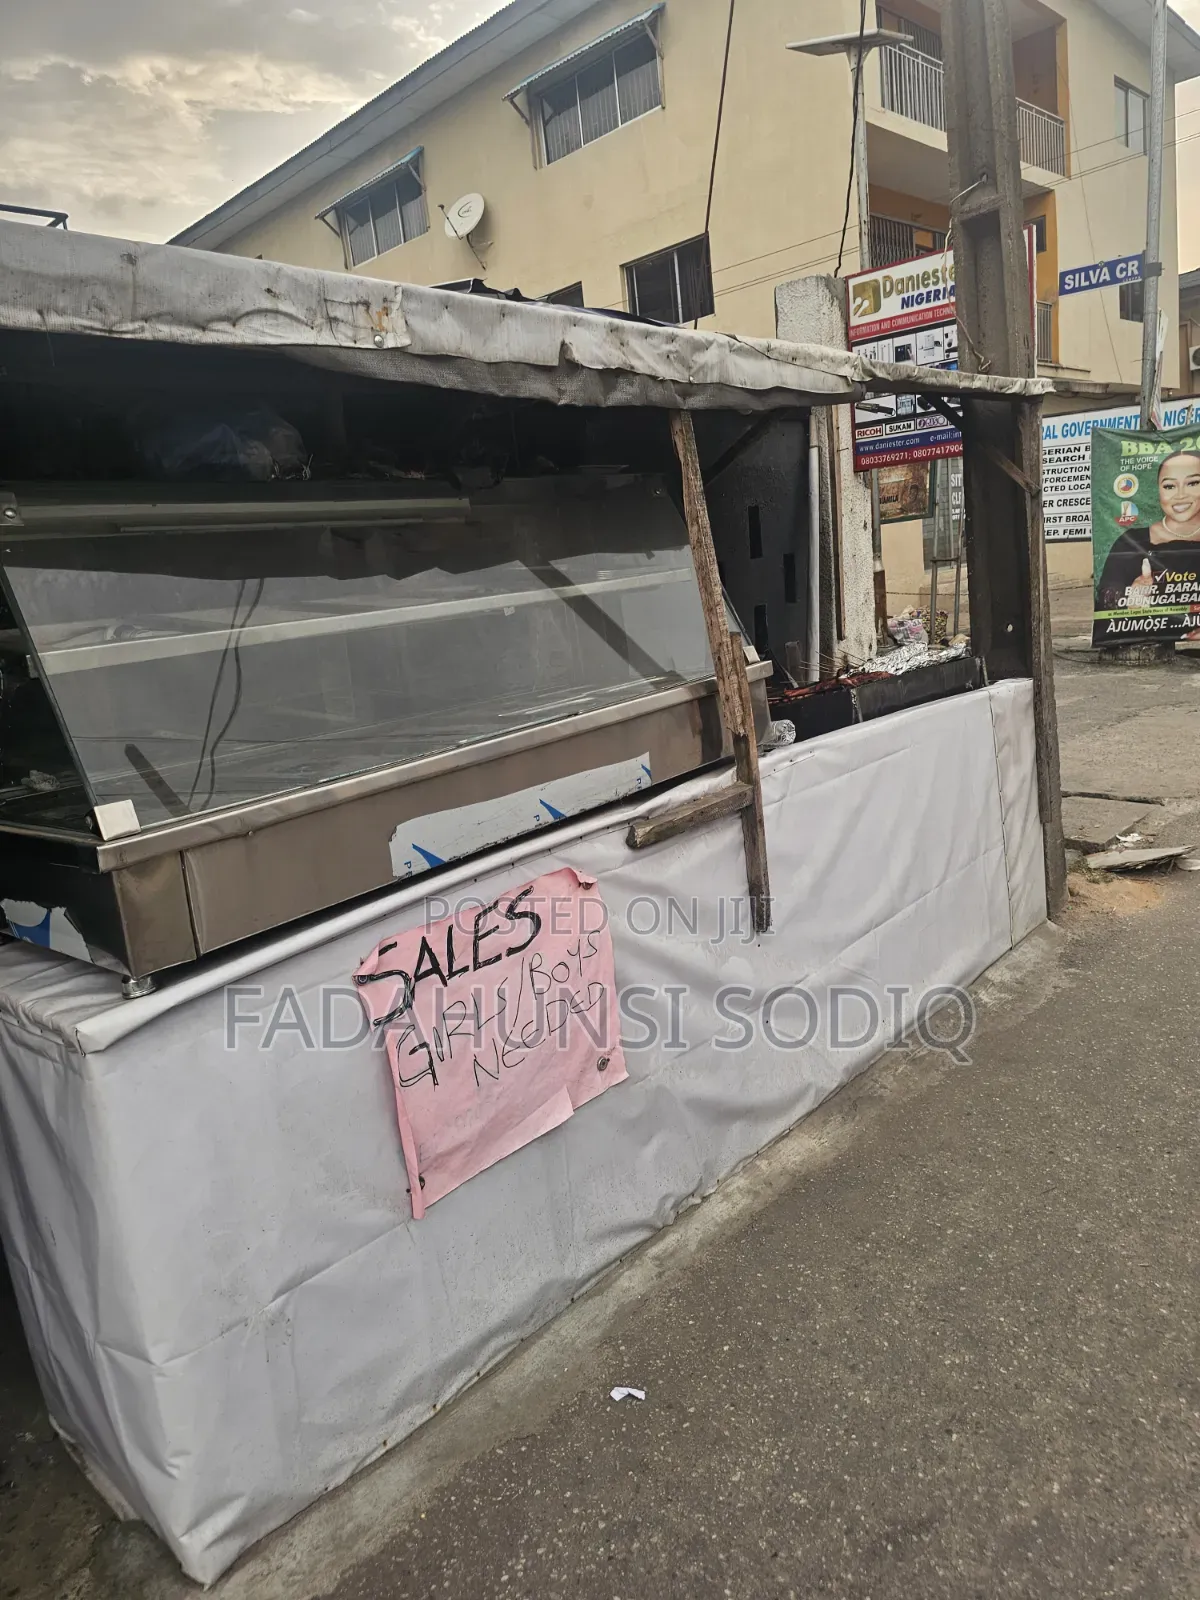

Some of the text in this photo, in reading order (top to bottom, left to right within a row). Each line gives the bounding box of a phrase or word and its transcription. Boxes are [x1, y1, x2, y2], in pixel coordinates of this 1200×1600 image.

[1064, 260, 1139, 290] SILVA CR
[857, 427, 882, 437] RICOH
[888, 423, 912, 433] SUKAM
[859, 437, 920, 452] www.daniester.com
[1121, 440, 1174, 457] BBA
[1121, 456, 1159, 466] THE VOICE
[1131, 463, 1152, 471] HOPE
[1165, 571, 1197, 582] Vote
[366, 885, 543, 1028] SALES
[472, 981, 606, 1087] NEEDED
